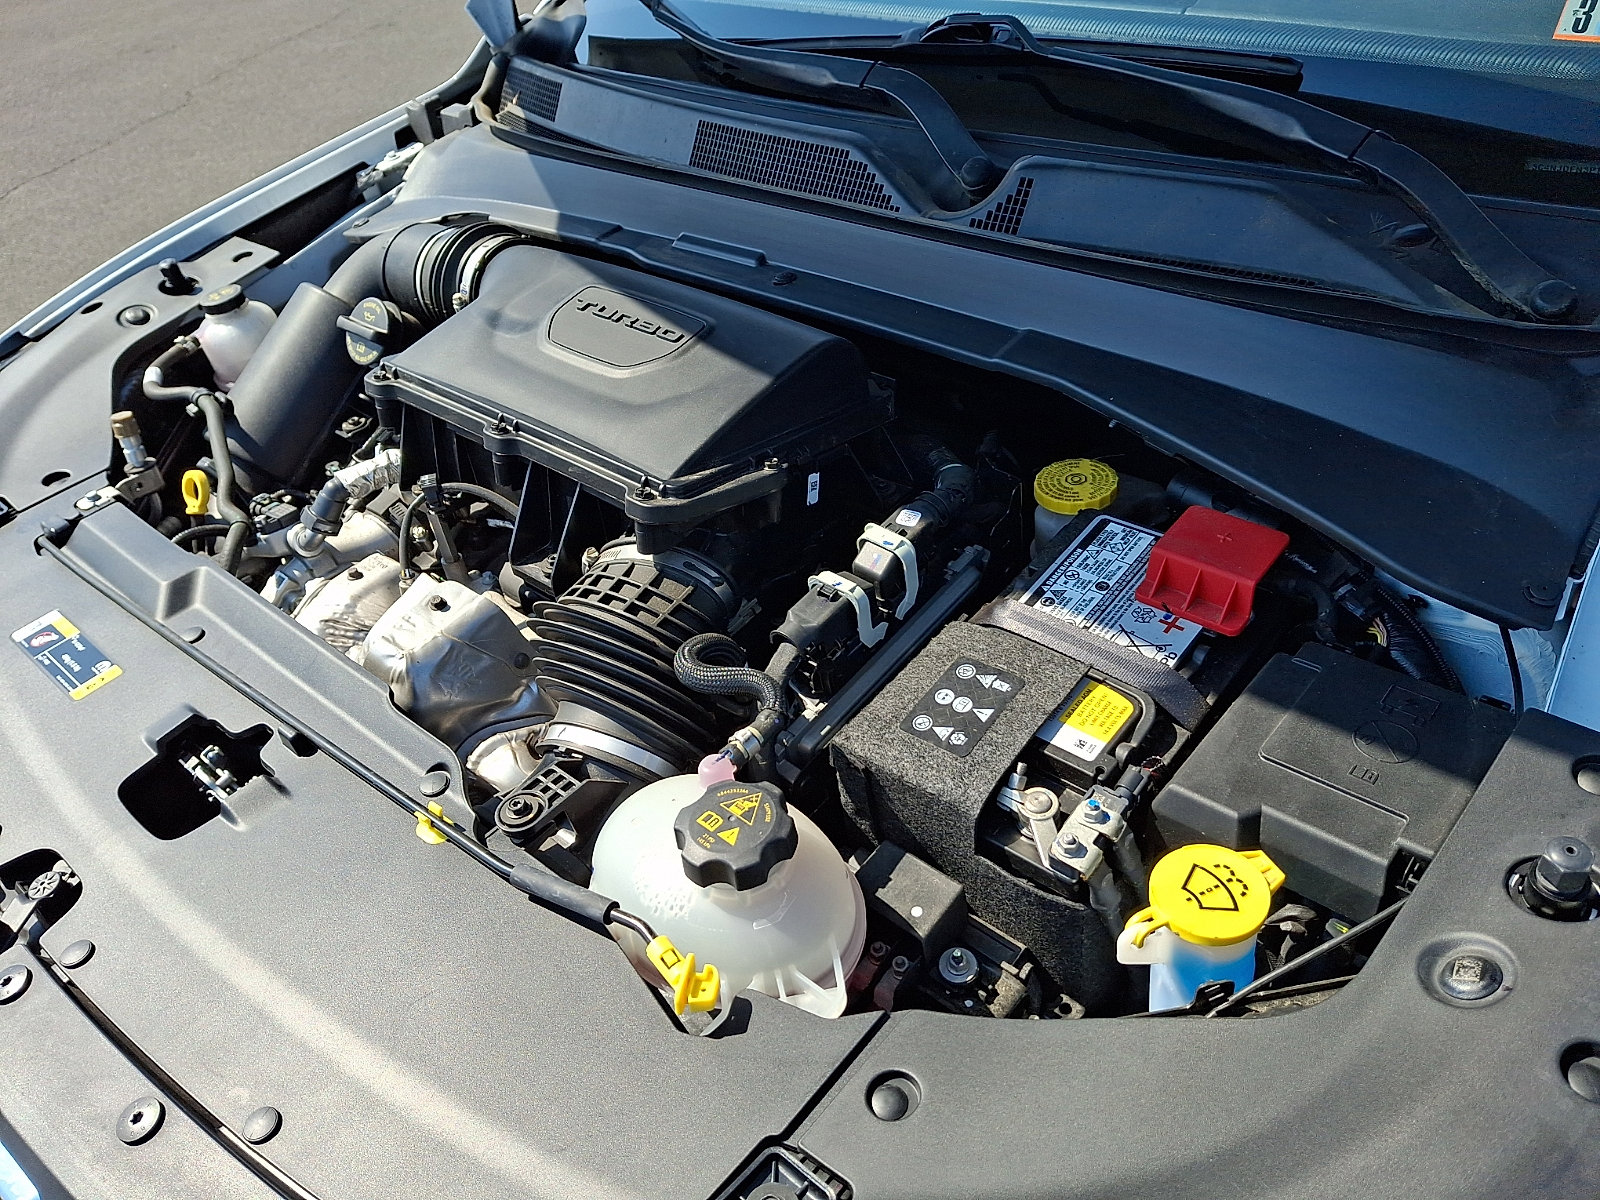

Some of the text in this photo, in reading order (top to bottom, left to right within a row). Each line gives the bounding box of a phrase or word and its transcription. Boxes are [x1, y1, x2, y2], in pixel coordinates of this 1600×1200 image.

[1571, 0, 1599, 34] 3
[575, 297, 686, 344] TURBO
[1048, 548, 1082, 585] DANGER/POISON
[1159, 648, 1178, 667] Pb
[1065, 687, 1092, 719] SEALED AGM
[1076, 694, 1096, 717] BATTERY
